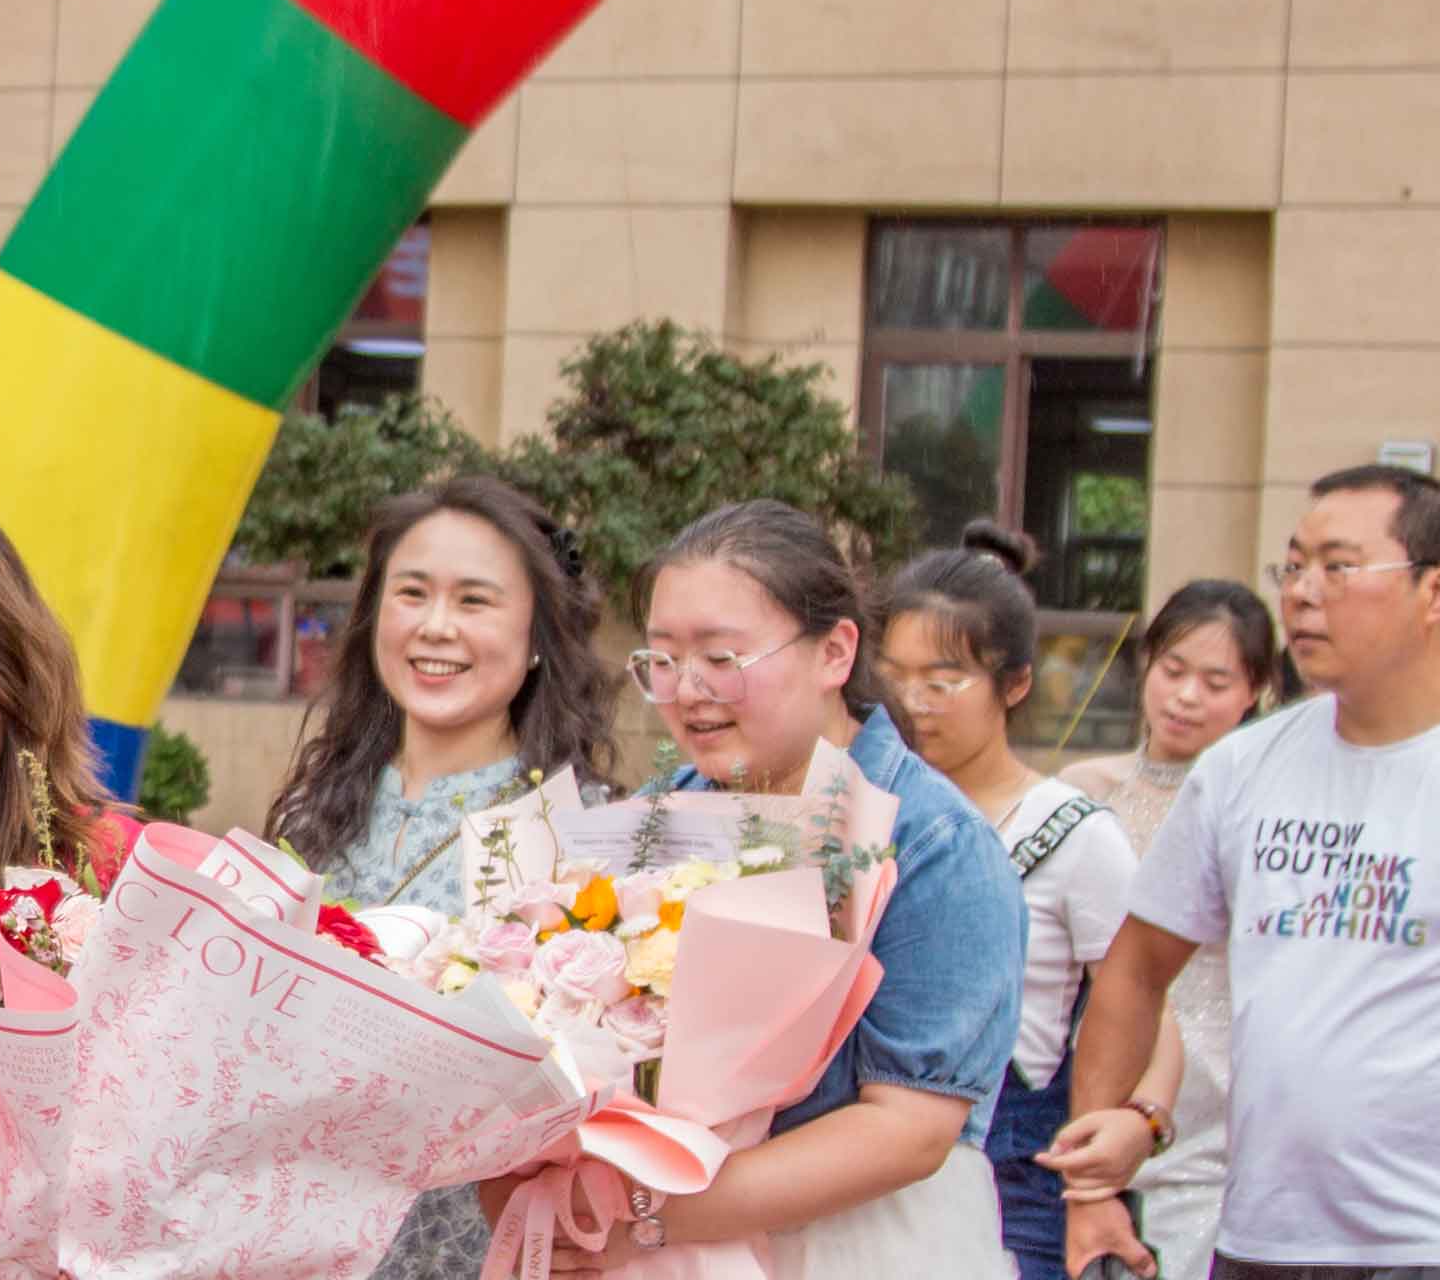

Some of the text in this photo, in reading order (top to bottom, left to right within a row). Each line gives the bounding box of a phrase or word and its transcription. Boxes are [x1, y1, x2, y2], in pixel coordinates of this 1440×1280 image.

[1256, 818, 1365, 849] I KNOW
[1253, 847, 1417, 883] YOU THINK
[168, 905, 316, 1019] LOVE
